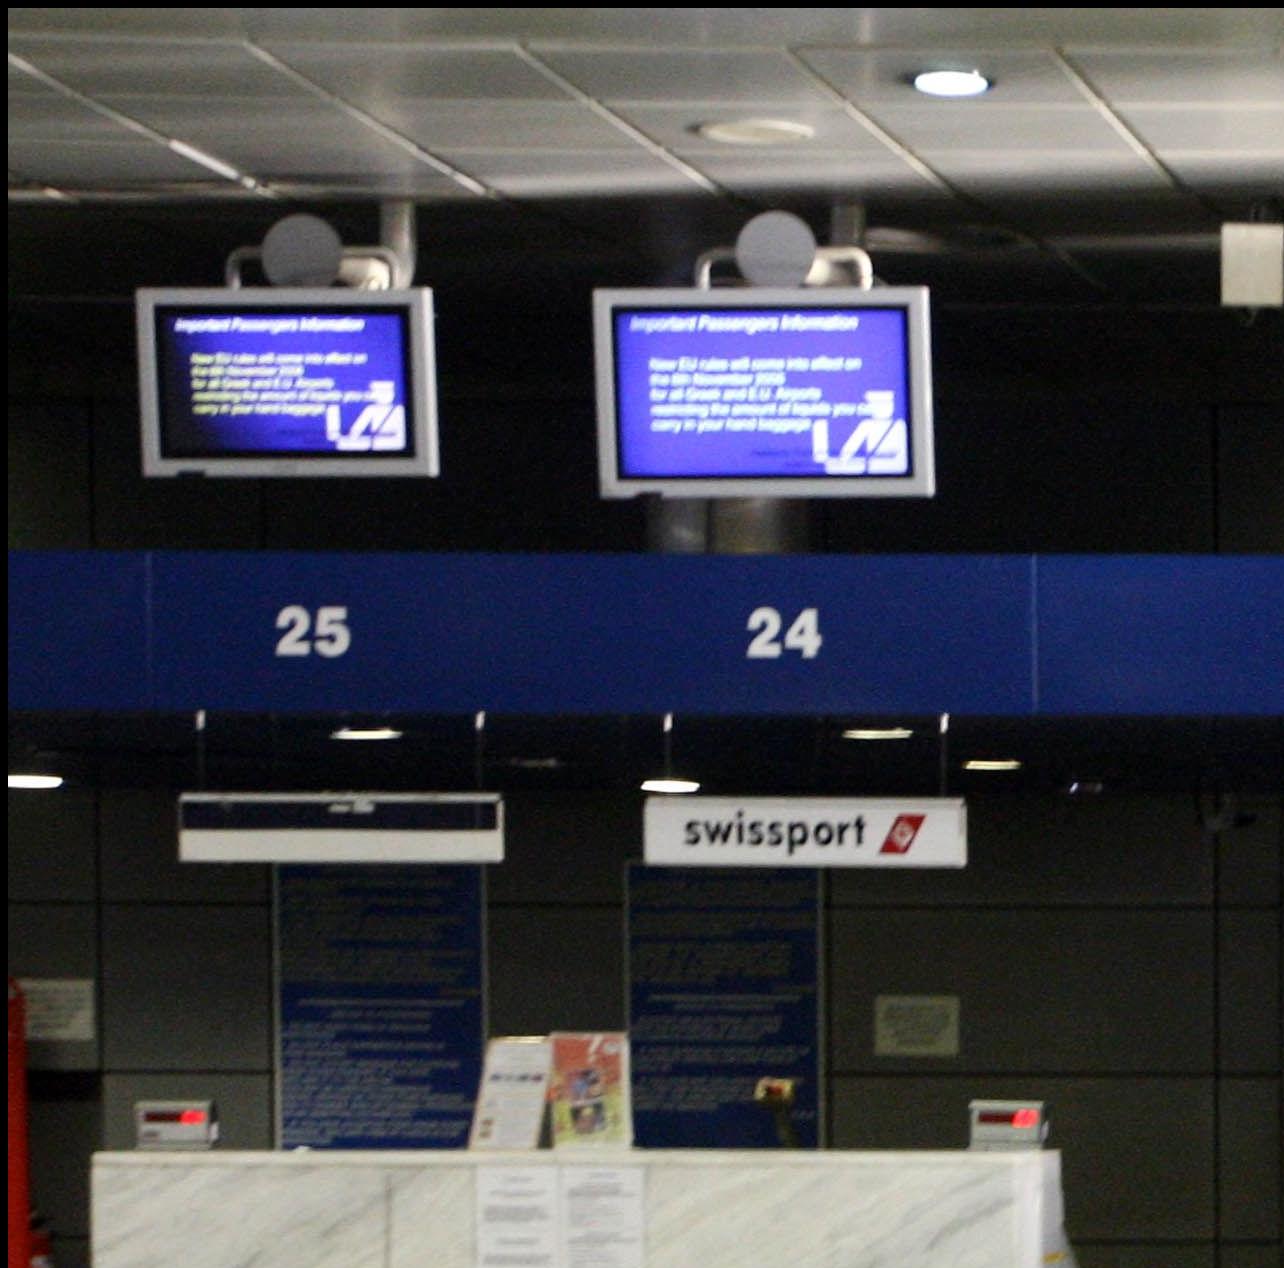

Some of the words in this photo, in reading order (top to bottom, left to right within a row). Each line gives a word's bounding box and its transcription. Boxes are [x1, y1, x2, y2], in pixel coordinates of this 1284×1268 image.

[276, 606, 350, 657] 25
[747, 606, 822, 658] 24
[685, 811, 866, 854] swissport
